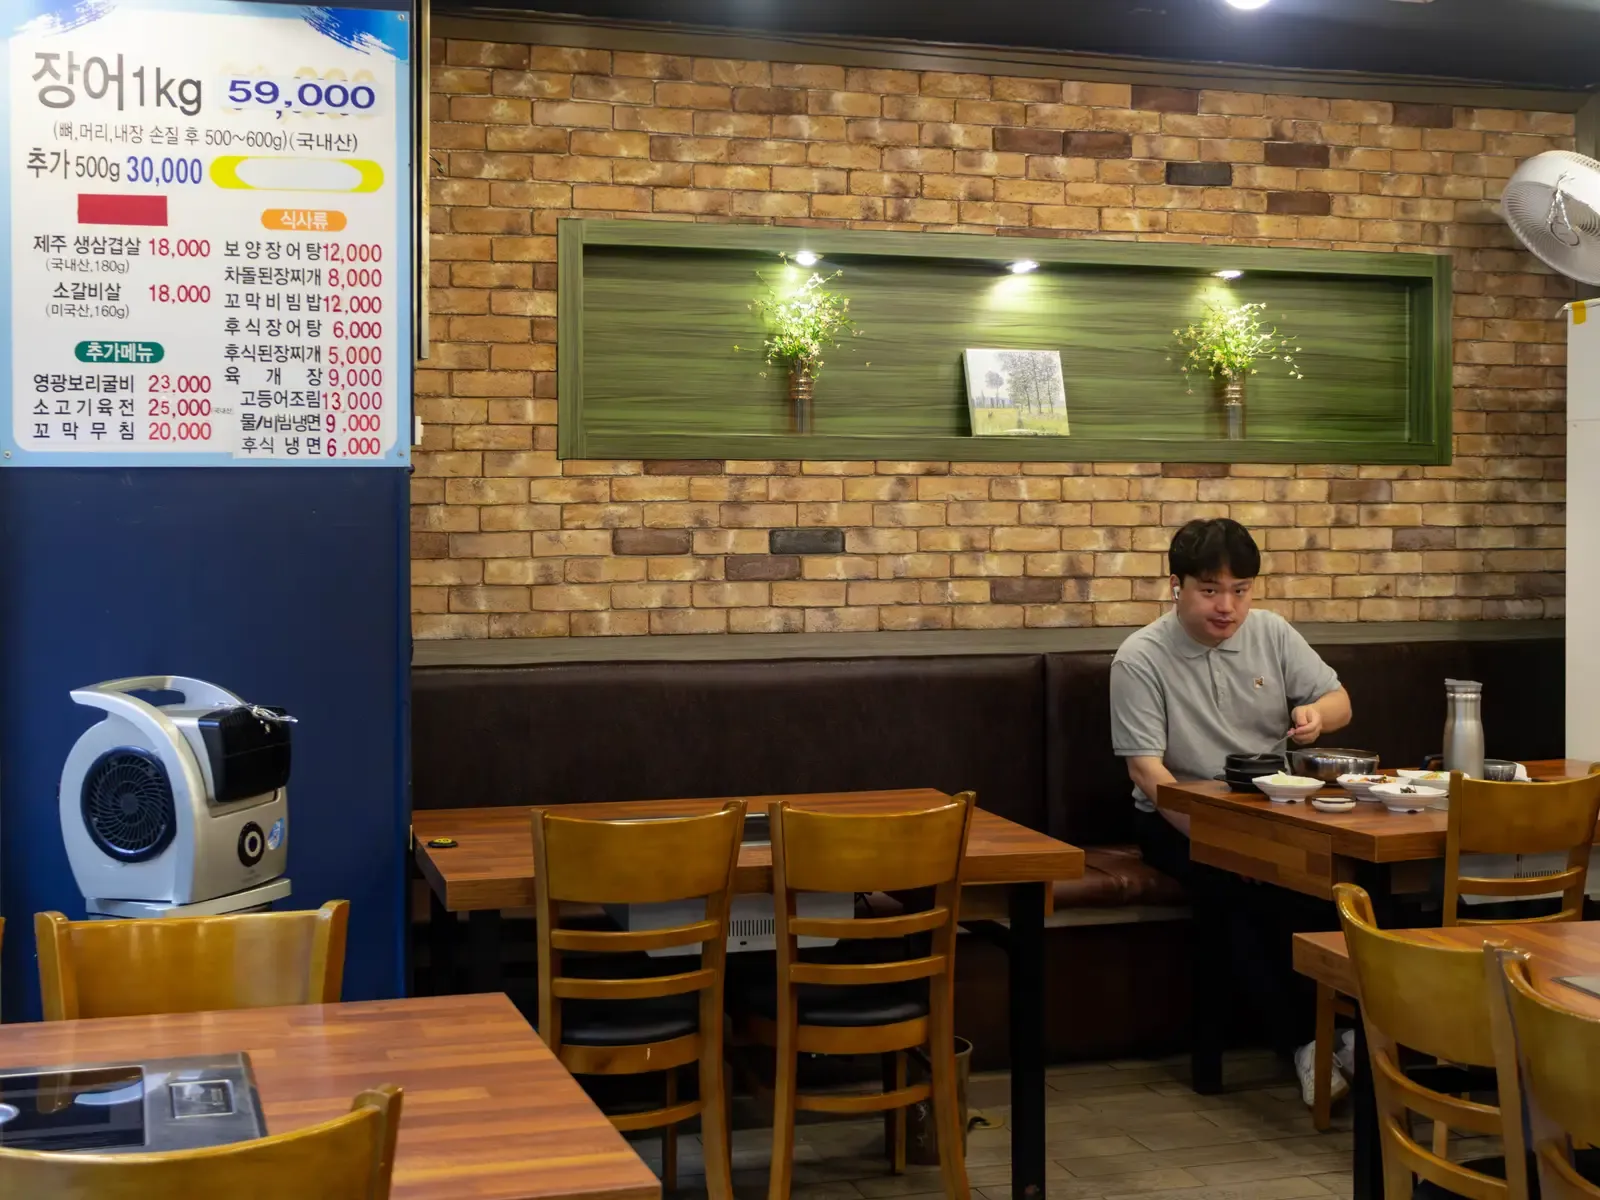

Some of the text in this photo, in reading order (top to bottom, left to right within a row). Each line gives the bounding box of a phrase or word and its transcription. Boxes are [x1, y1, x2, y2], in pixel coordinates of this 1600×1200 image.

[228, 79, 376, 110] 59,000
[150, 126, 178, 145] 손질
[185, 127, 199, 144] 후
[27, 148, 202, 186] 추가 500g 30,000
[280, 211, 328, 230] 식사류
[34, 235, 210, 257] 제주 생삼겹살 18,000
[323, 243, 382, 264] 12,000
[225, 267, 382, 289] 차돌된장찌개 8,000
[53, 282, 210, 303] 소갈비살 18,000
[225, 293, 382, 314] 꼬막비빔밥 12,000
[333, 321, 381, 340] 6,000
[86, 342, 154, 362] 추가메뉴
[224, 344, 381, 366] 후식된장찌개 5,000
[34, 374, 133, 393] 영광보리굴비
[329, 369, 382, 390] 9,000
[149, 399, 211, 418] 25,000
[241, 390, 320, 408] 고등어조림
[149, 422, 211, 441] 20,000
[241, 414, 320, 432] 물/비빔냉면
